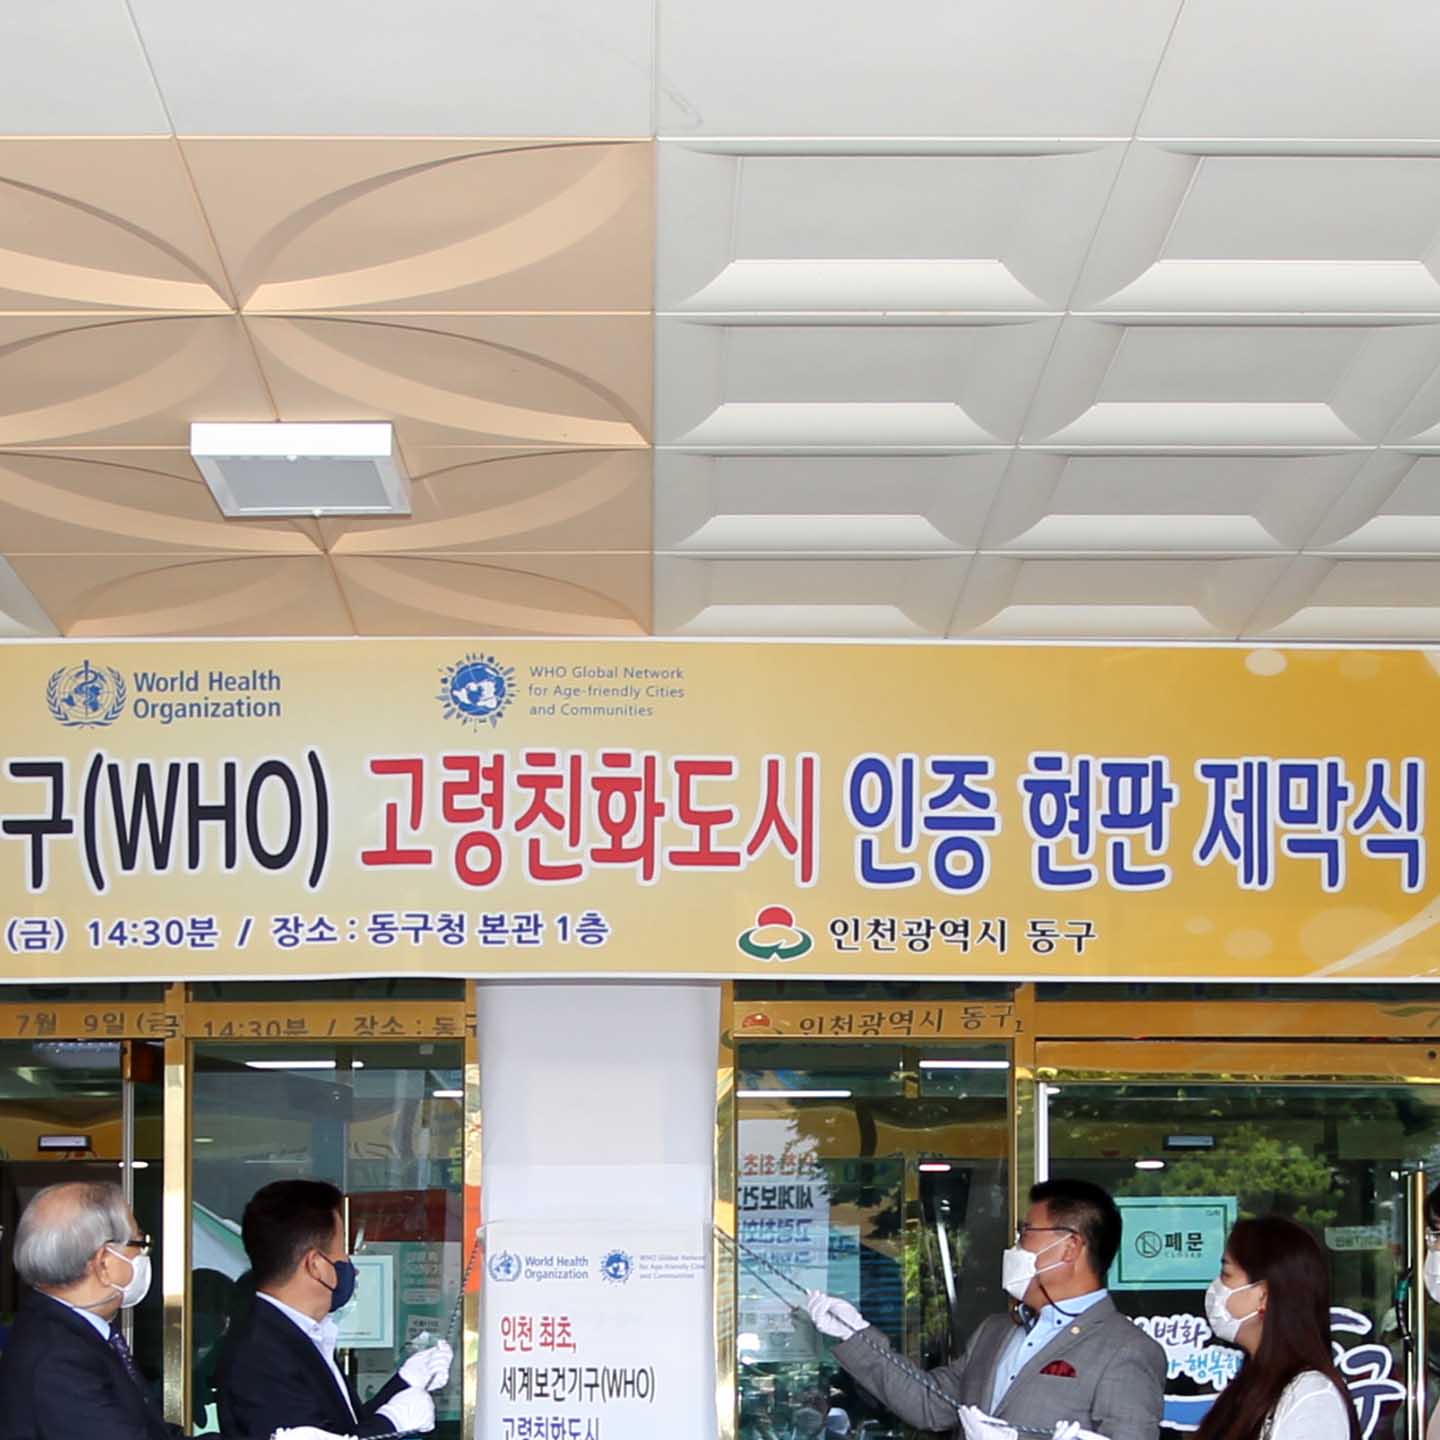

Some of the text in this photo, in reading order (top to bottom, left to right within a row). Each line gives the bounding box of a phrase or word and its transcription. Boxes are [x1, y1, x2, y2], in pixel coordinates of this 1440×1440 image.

[133, 670, 281, 693] World Health
[529, 665, 684, 679] WHO Global Network
[528, 684, 685, 699] for Age-friendly Cities
[133, 696, 281, 723] Organization
[529, 704, 653, 717] and Communities
[361, 753, 815, 886] 고령친화도시
[849, 756, 998, 889] 인증
[1022, 755, 1173, 887] 현판
[1197, 760, 1421, 889] 제막식
[89, 917, 219, 949] 14:30분
[272, 916, 338, 948] 장소
[366, 913, 466, 946] 동구청
[477, 914, 543, 946] 본관
[556, 914, 609, 946] 1층
[828, 917, 1097, 954] 인천광역시 동구
[525, 1255, 589, 1267] World Health
[525, 1268, 589, 1281] Organization
[500, 1316, 577, 1352] 인천 최초,
[1154, 1319, 1206, 1348] 변화
[500, 1366, 655, 1403] 세계보건기구(WHO)
